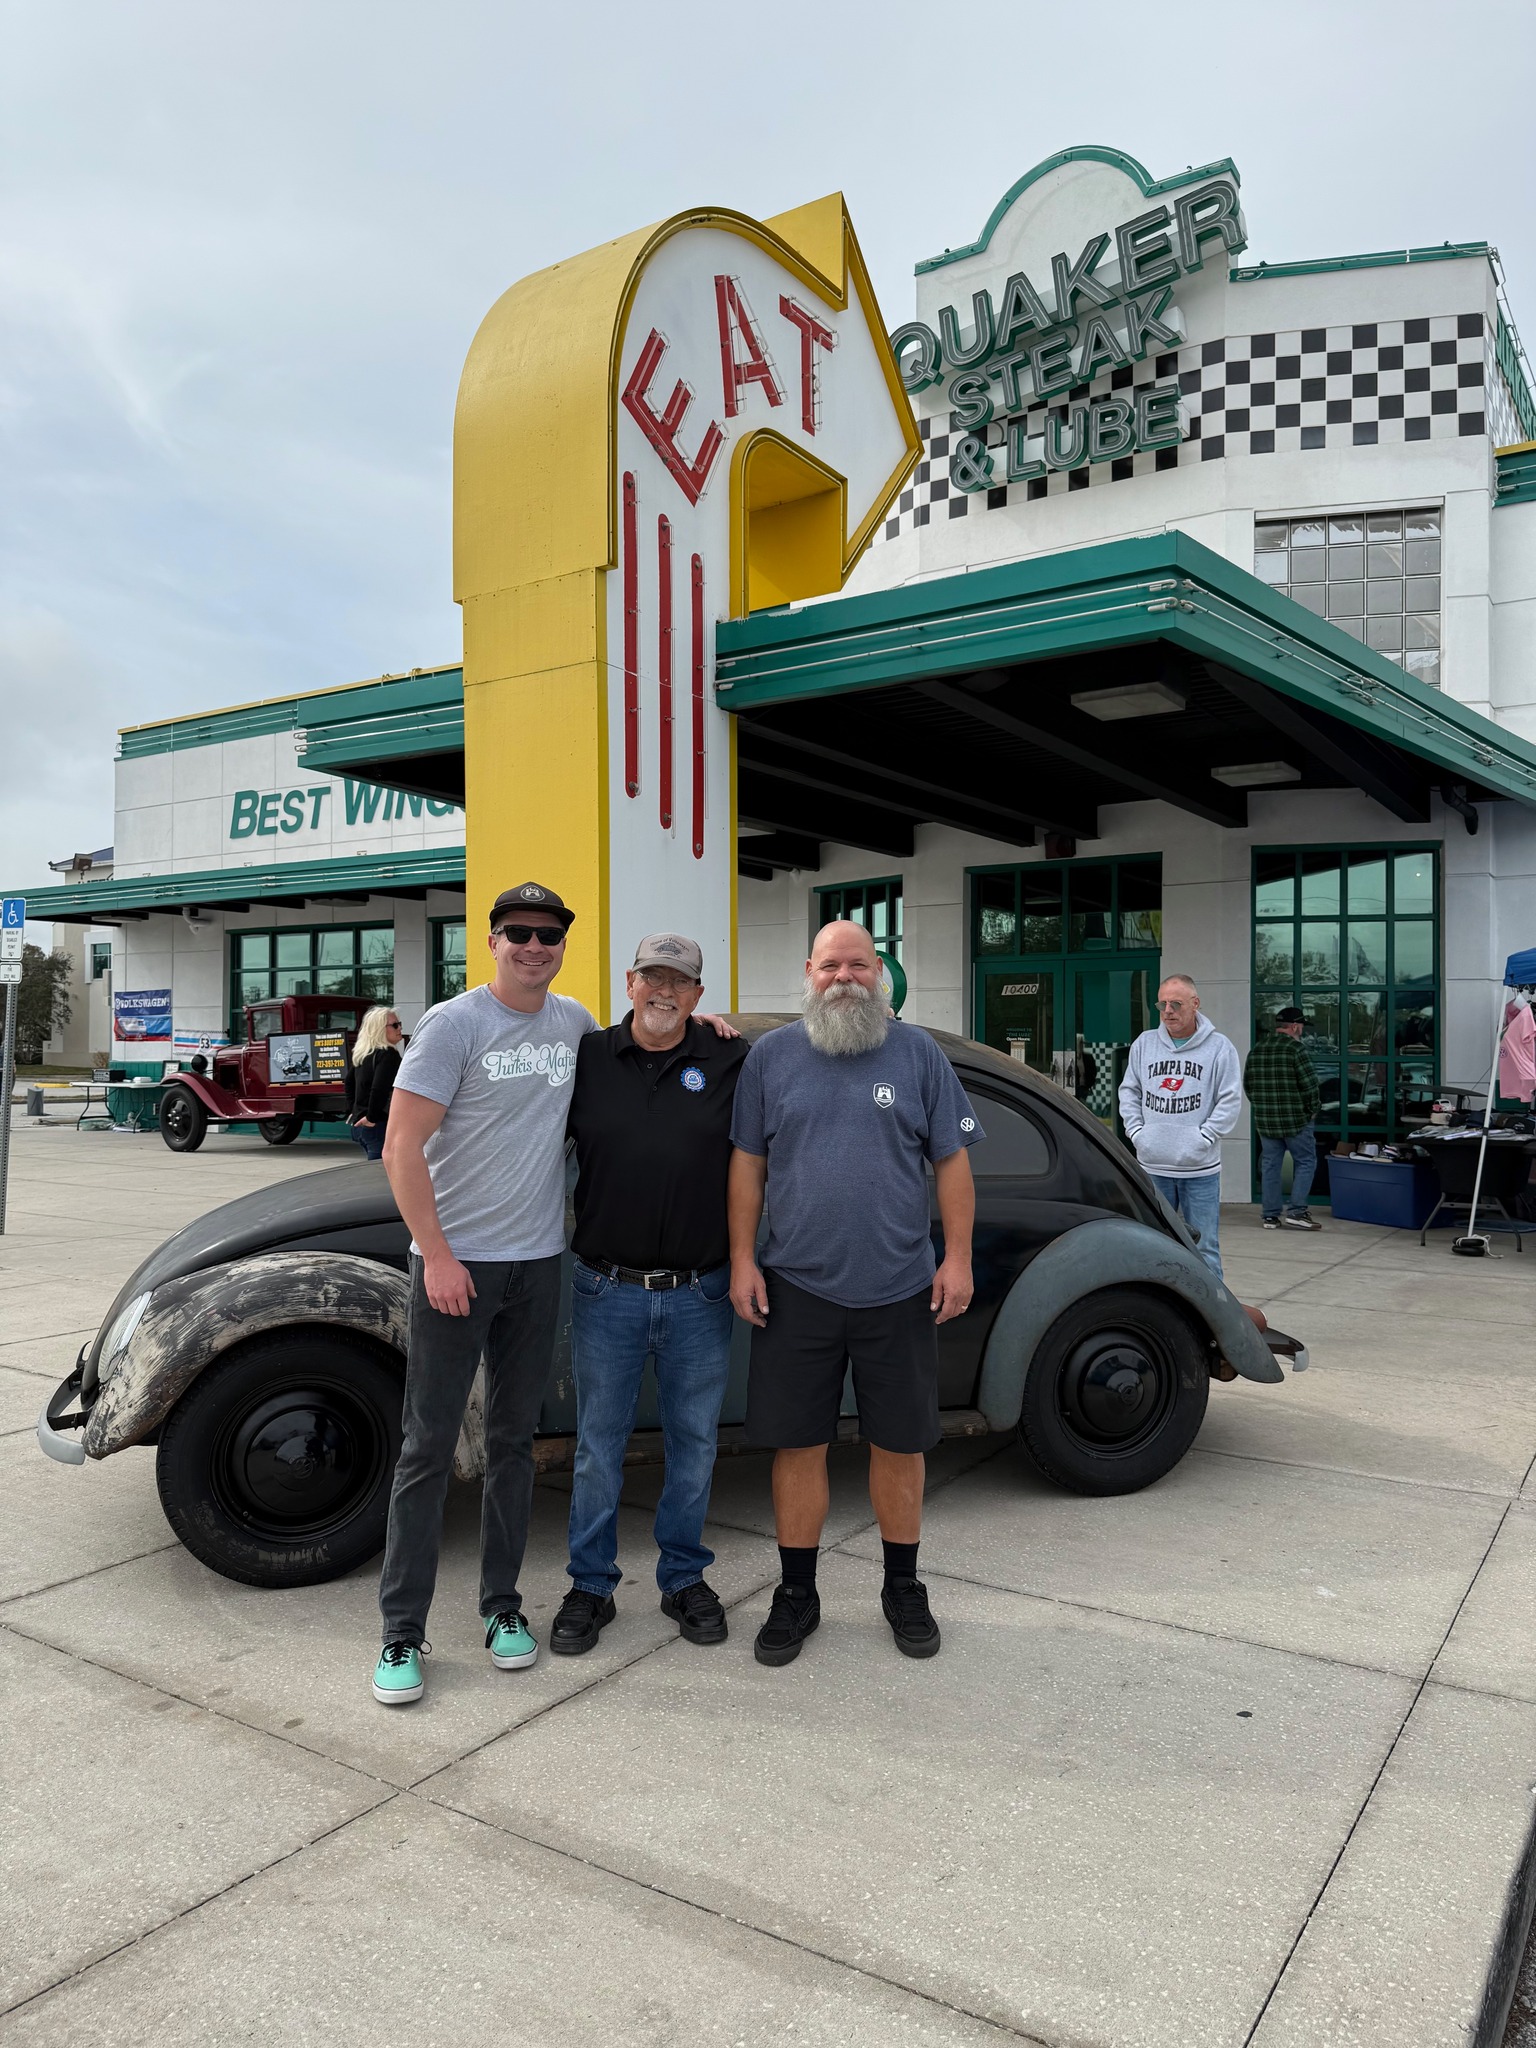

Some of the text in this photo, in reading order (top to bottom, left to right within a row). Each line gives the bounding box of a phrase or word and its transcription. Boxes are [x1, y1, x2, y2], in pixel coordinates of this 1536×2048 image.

[889, 180, 1248, 395] QUAKER
[949, 285, 1183, 431] STEAK
[621, 274, 838, 508] EAT
[951, 384, 1183, 493] & LUBE
[230, 778, 466, 839] BEST WING
[120, 997, 167, 1008] VOLKSWAGEN
[1004, 984, 1038, 994] 10400
[200, 1038, 210, 1049] 53
[485, 1043, 576, 1084] Turkis Mafia
[1148, 1060, 1203, 1081] TAMPA BAY
[1145, 1090, 1202, 1114] BUCCANEERS
